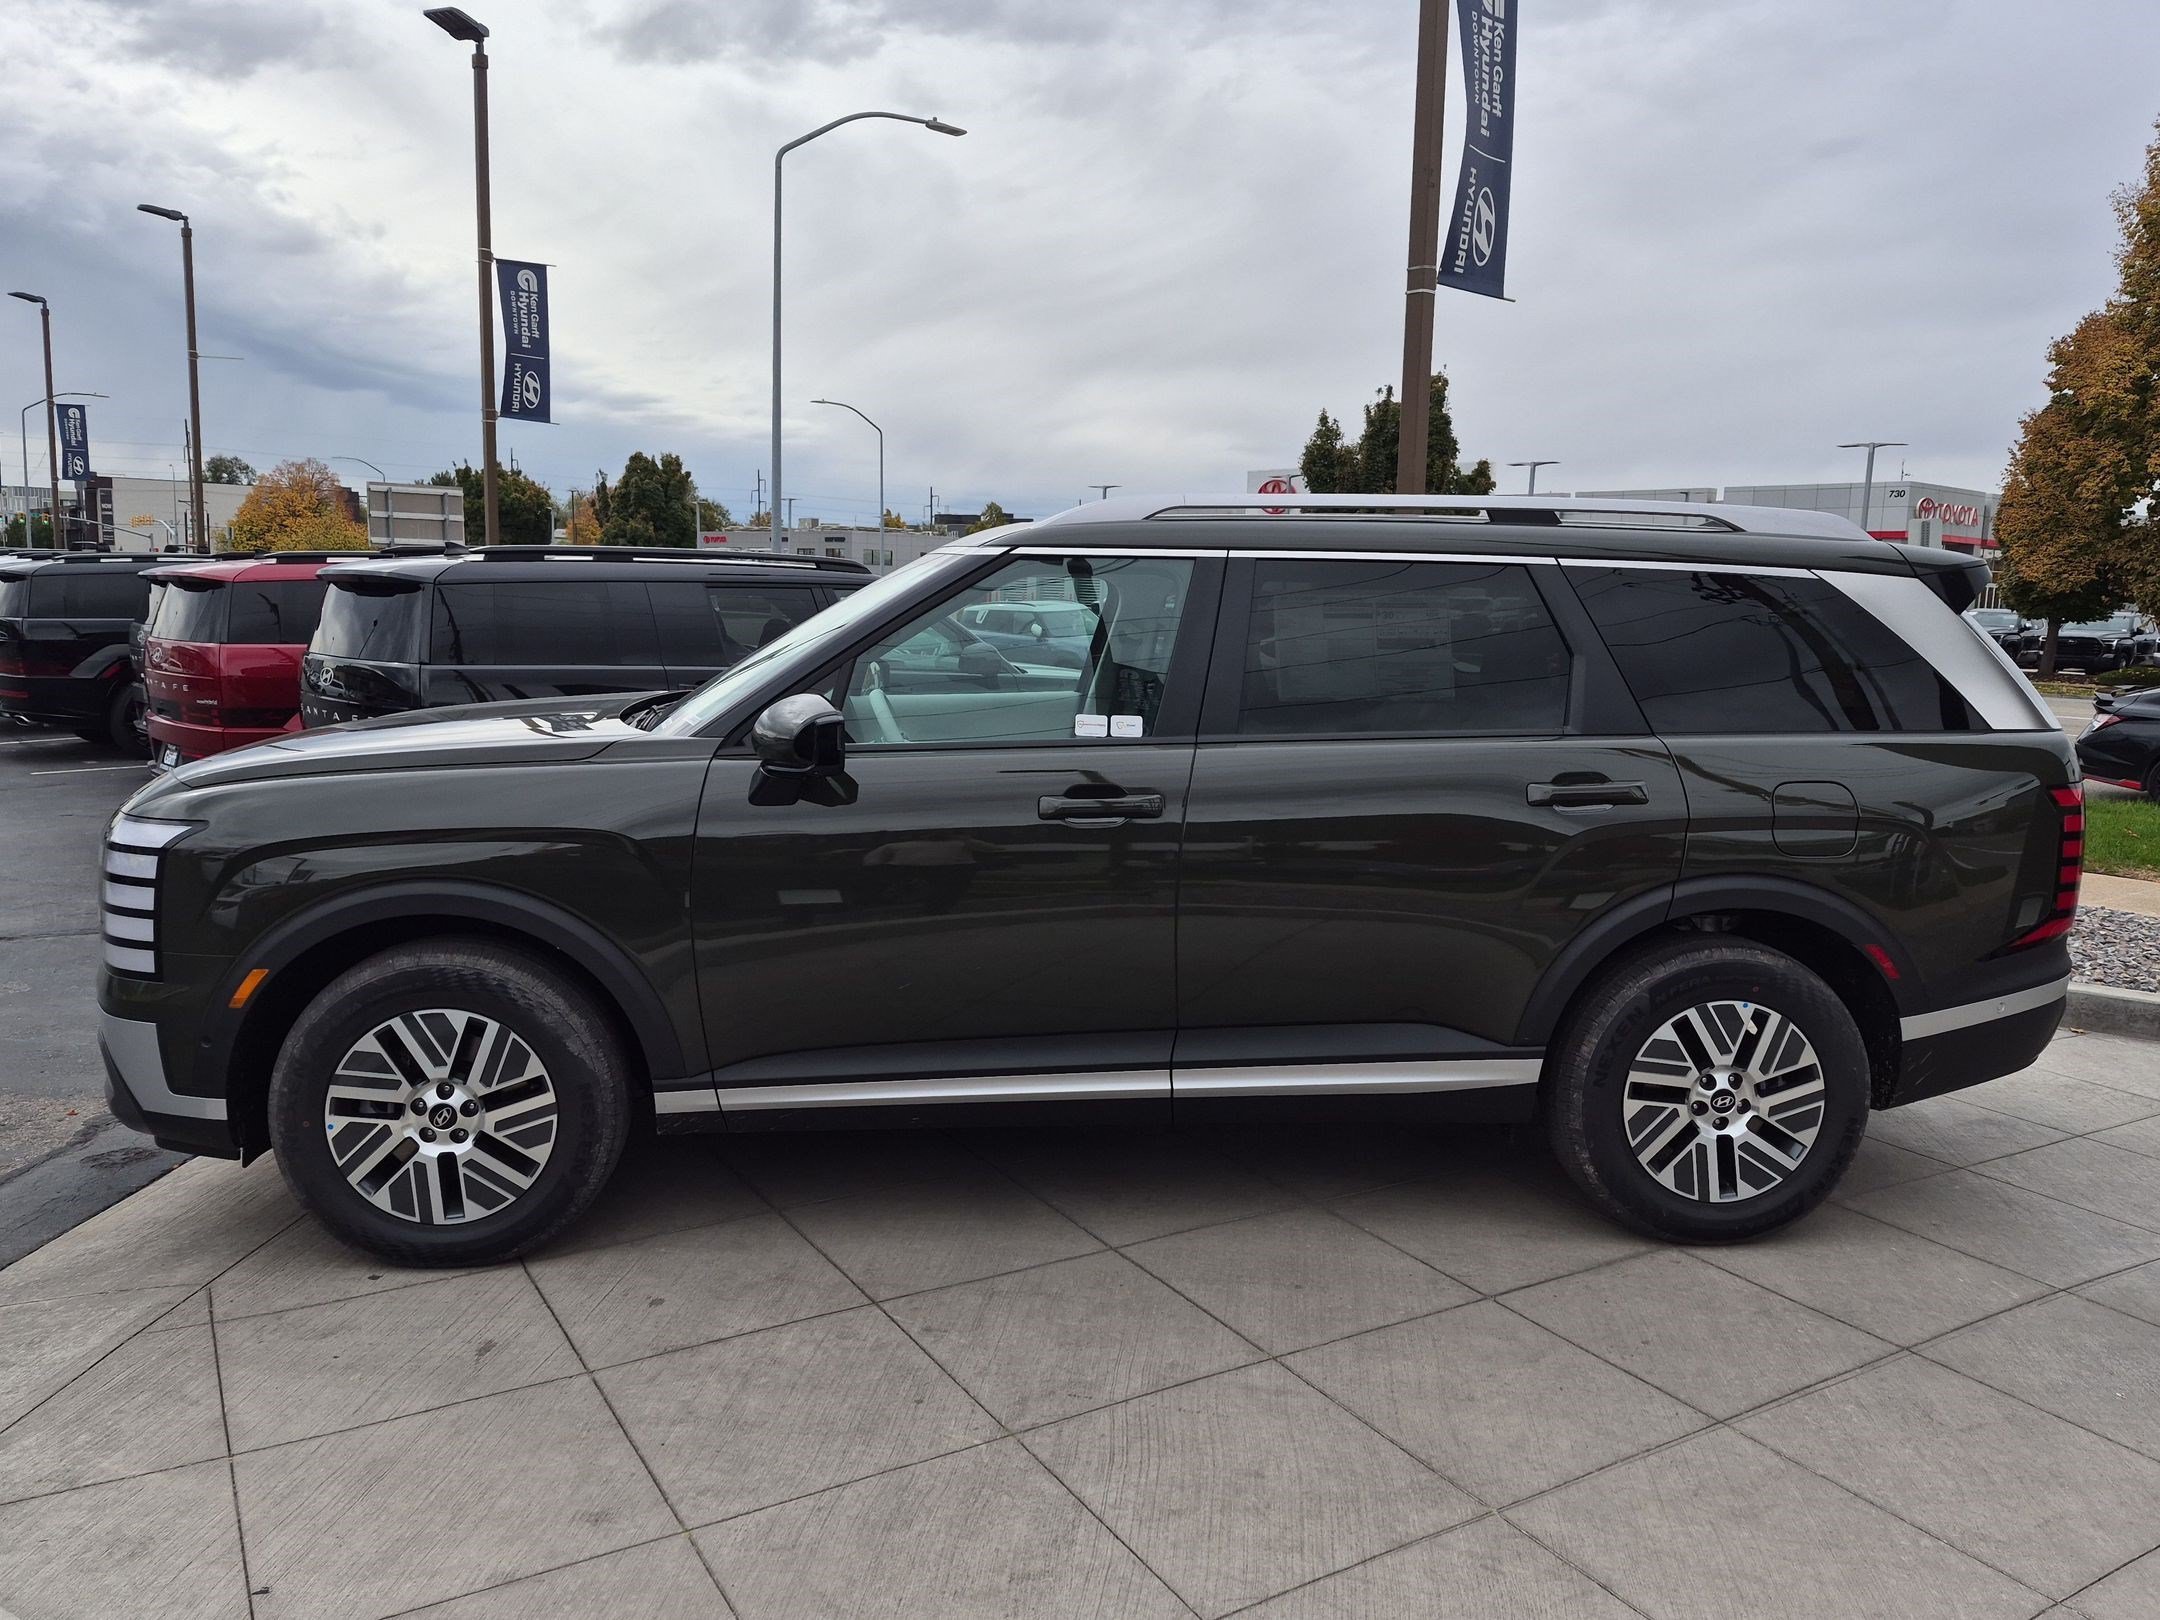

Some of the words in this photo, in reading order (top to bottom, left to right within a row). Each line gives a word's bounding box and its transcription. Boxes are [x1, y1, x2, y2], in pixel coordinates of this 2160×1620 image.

[1471, 10, 1480, 105] DOWNTOWN
[1493, 21, 1504, 62] Ken
[1479, 15, 1494, 138] Hyundai
[1491, 65, 1504, 118] Garff
[1453, 167, 1478, 275] HYUNDAI
[510, 290, 519, 335] DOWNTOWN
[517, 291, 532, 349] Hyundai
[530, 293, 539, 313] Ken
[531, 314, 540, 339] Garff
[511, 362, 522, 413] HYUNDAI
[68, 418, 78, 447] Hyundai
[1888, 489, 1906, 498] 730
[1936, 503, 1979, 527] TOYOTA
